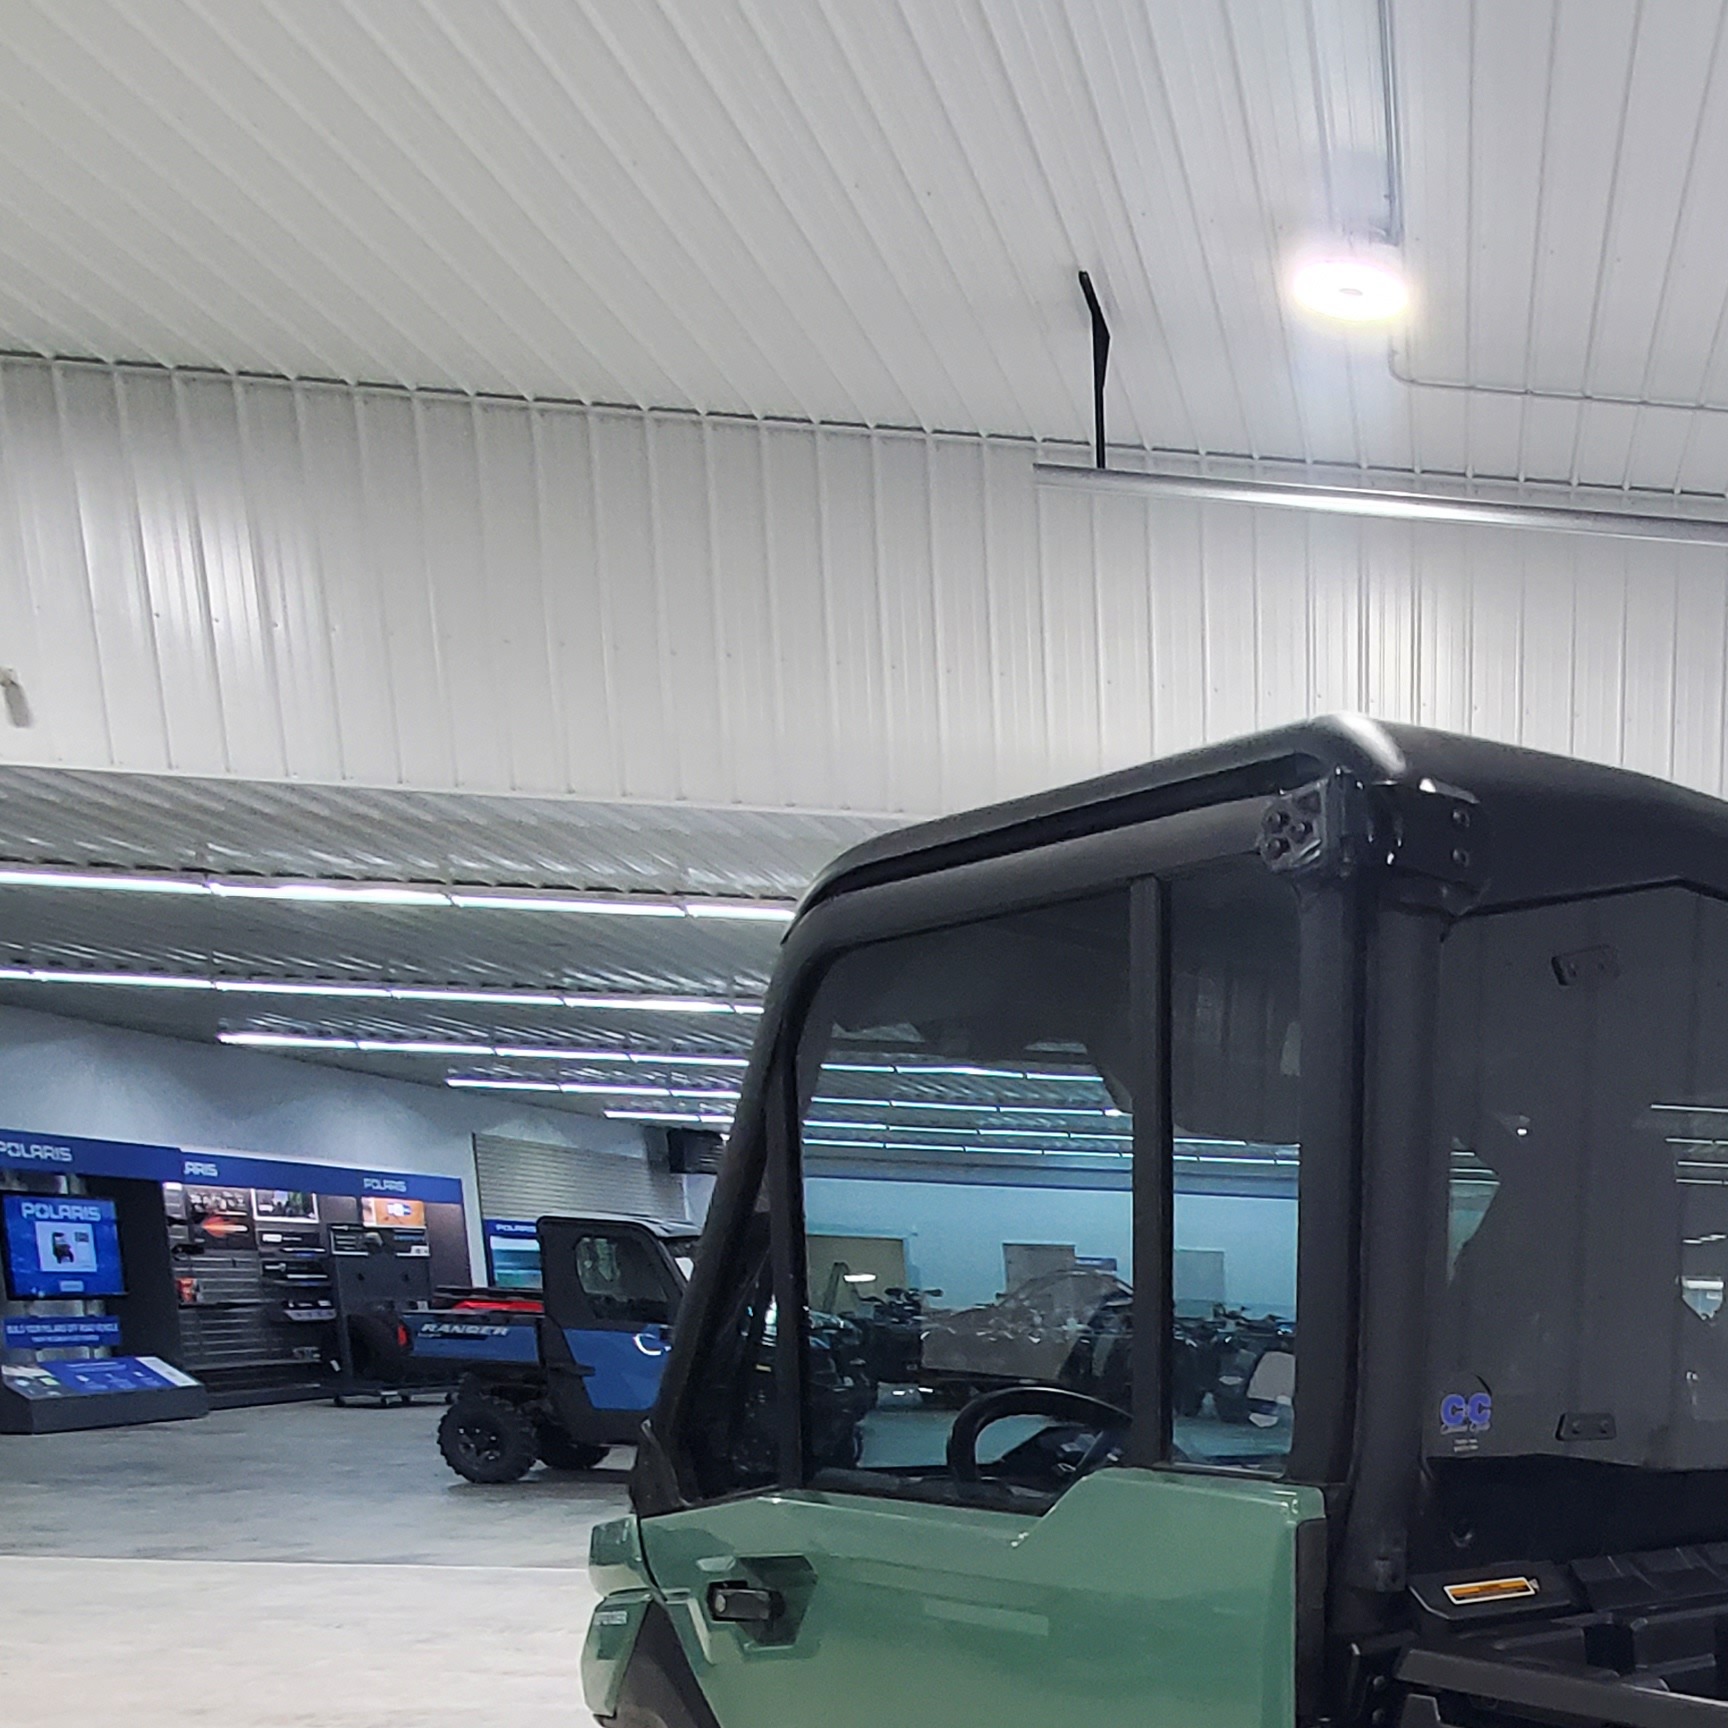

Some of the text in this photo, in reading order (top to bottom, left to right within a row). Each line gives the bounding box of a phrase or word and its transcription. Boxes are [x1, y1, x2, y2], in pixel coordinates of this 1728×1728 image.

[0, 1140, 73, 1162] POLARIS
[363, 1178, 407, 1192] POLARIS
[21, 1202, 101, 1222] POLARIS
[421, 1323, 509, 1336] RANGER
